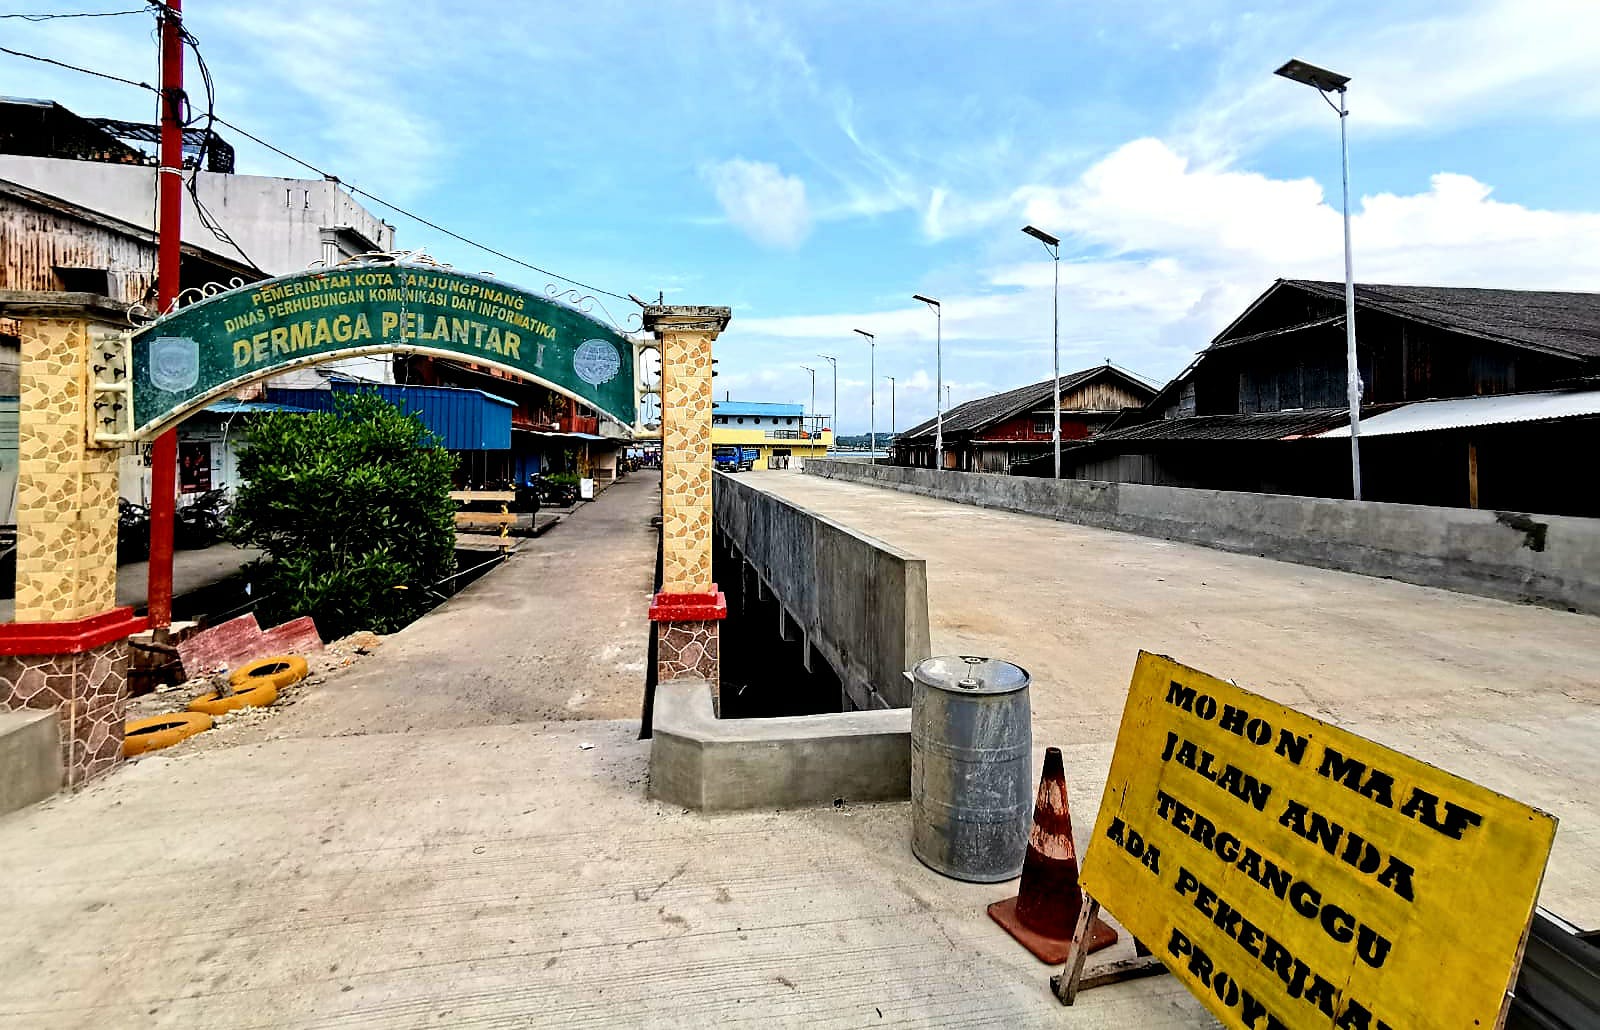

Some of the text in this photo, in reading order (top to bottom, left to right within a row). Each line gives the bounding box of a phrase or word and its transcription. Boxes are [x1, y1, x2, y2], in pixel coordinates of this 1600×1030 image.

[224, 287, 558, 342] DINAS PERHUBUNGAN KOMUNIKASI DAN INFORMATIKA
[232, 312, 372, 369] DERMAGA
[382, 311, 521, 361] PELANTAR
[252, 272, 525, 311] PEMERINTAH KOTA TANJUNGPINANG
[1161, 731, 1416, 903] JALAN ANDA
[1165, 680, 1483, 842] MOHON MAAF
[1106, 816, 1394, 1030] ADA PEKERJAA
[1156, 789, 1393, 970] TERGANGGU
